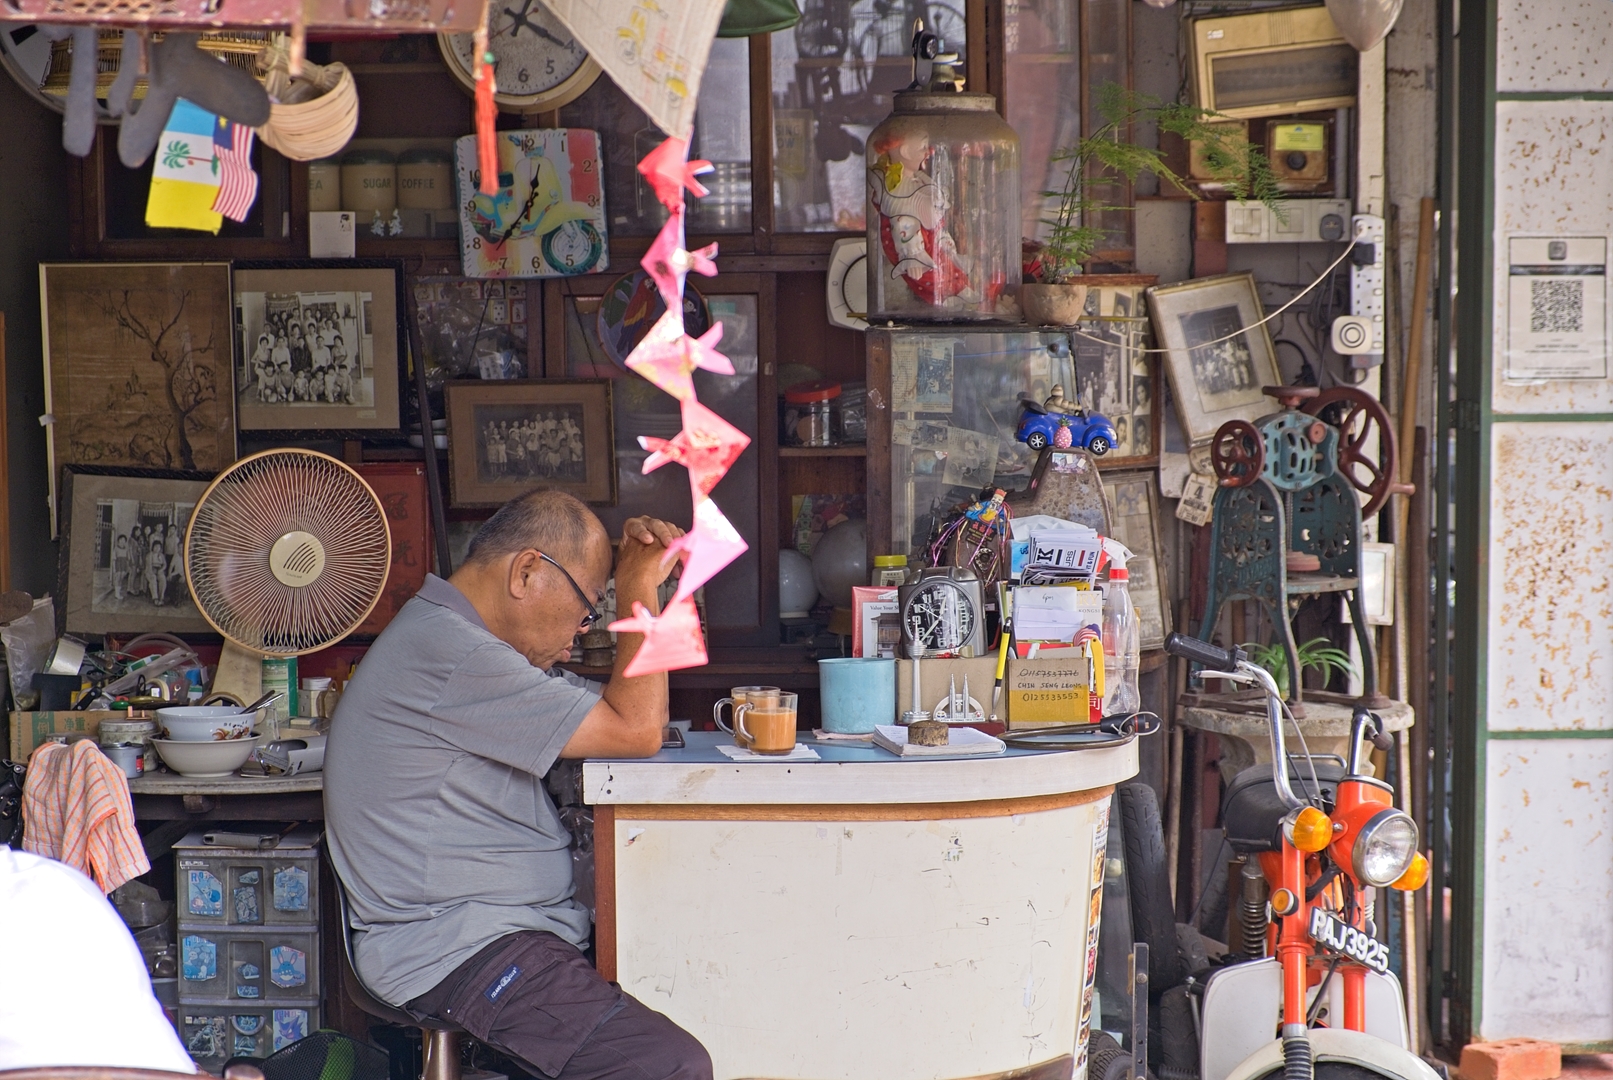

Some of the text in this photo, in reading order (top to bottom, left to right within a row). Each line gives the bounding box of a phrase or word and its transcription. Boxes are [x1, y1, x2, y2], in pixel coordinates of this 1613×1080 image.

[546, 56, 555, 75] 5
[518, 68, 529, 83] 6
[521, 138, 535, 152] 12
[560, 140, 565, 153] 1
[582, 159, 592, 173] 2
[363, 178, 392, 189] SUGAR
[401, 178, 435, 189] COFFEE
[467, 200, 477, 213] 9
[588, 194, 597, 208] 3
[472, 236, 482, 250] 8
[587, 230, 597, 243] 4
[500, 257, 509, 270] 7
[531, 256, 541, 269] 6
[565, 254, 574, 267] 5
[1311, 907, 1390, 972] PAJ3925
